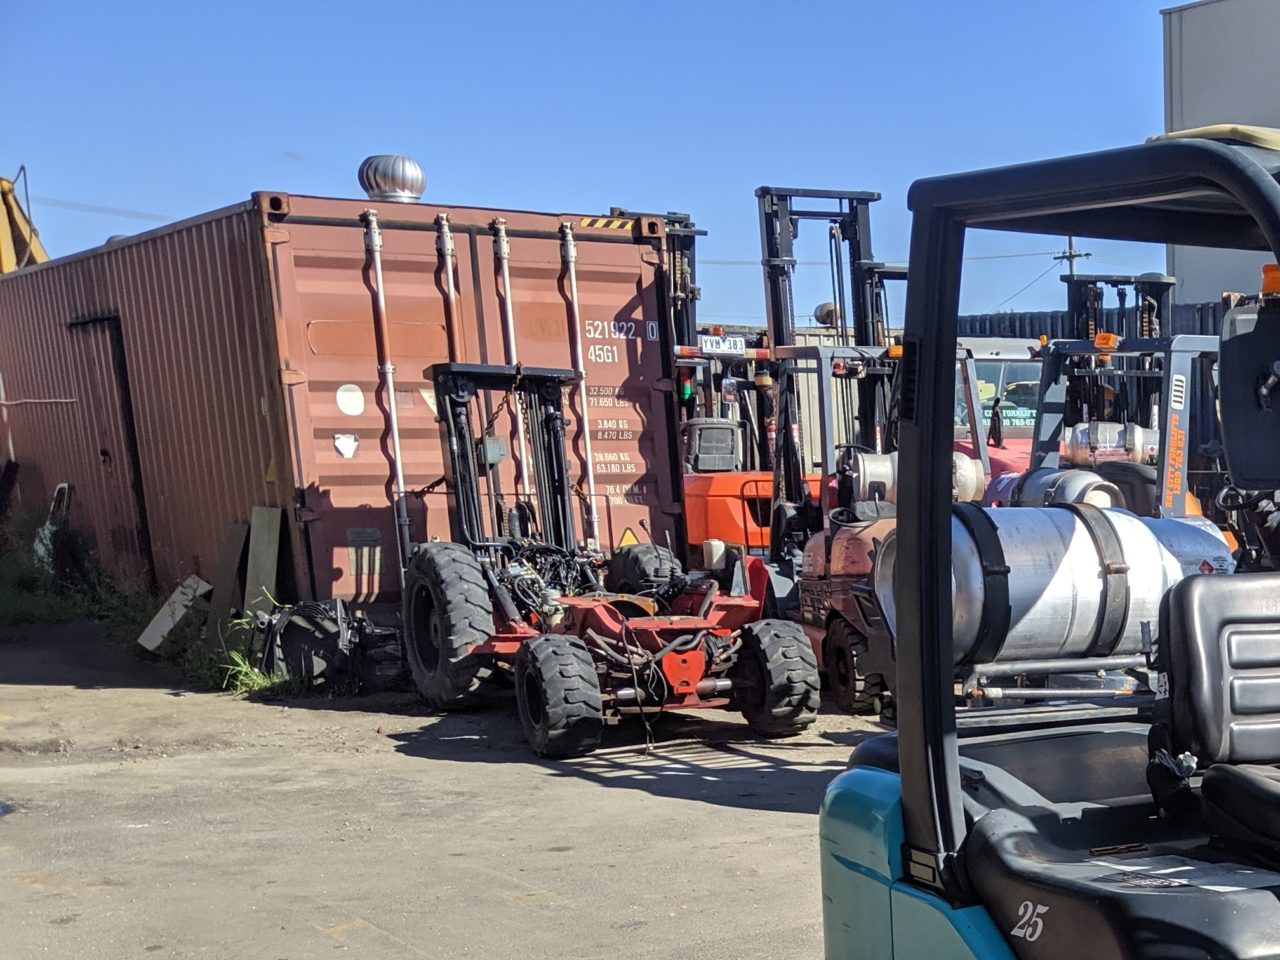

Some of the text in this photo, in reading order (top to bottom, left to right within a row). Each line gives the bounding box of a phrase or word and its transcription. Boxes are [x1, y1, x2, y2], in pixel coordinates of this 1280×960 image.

[585, 320, 657, 340] 521922 0
[587, 344, 619, 363] 45G1
[619, 430, 633, 440] LBS
[622, 463, 636, 473] LBS
[1167, 466, 1176, 489] CITY
[1010, 900, 1050, 942] 25
